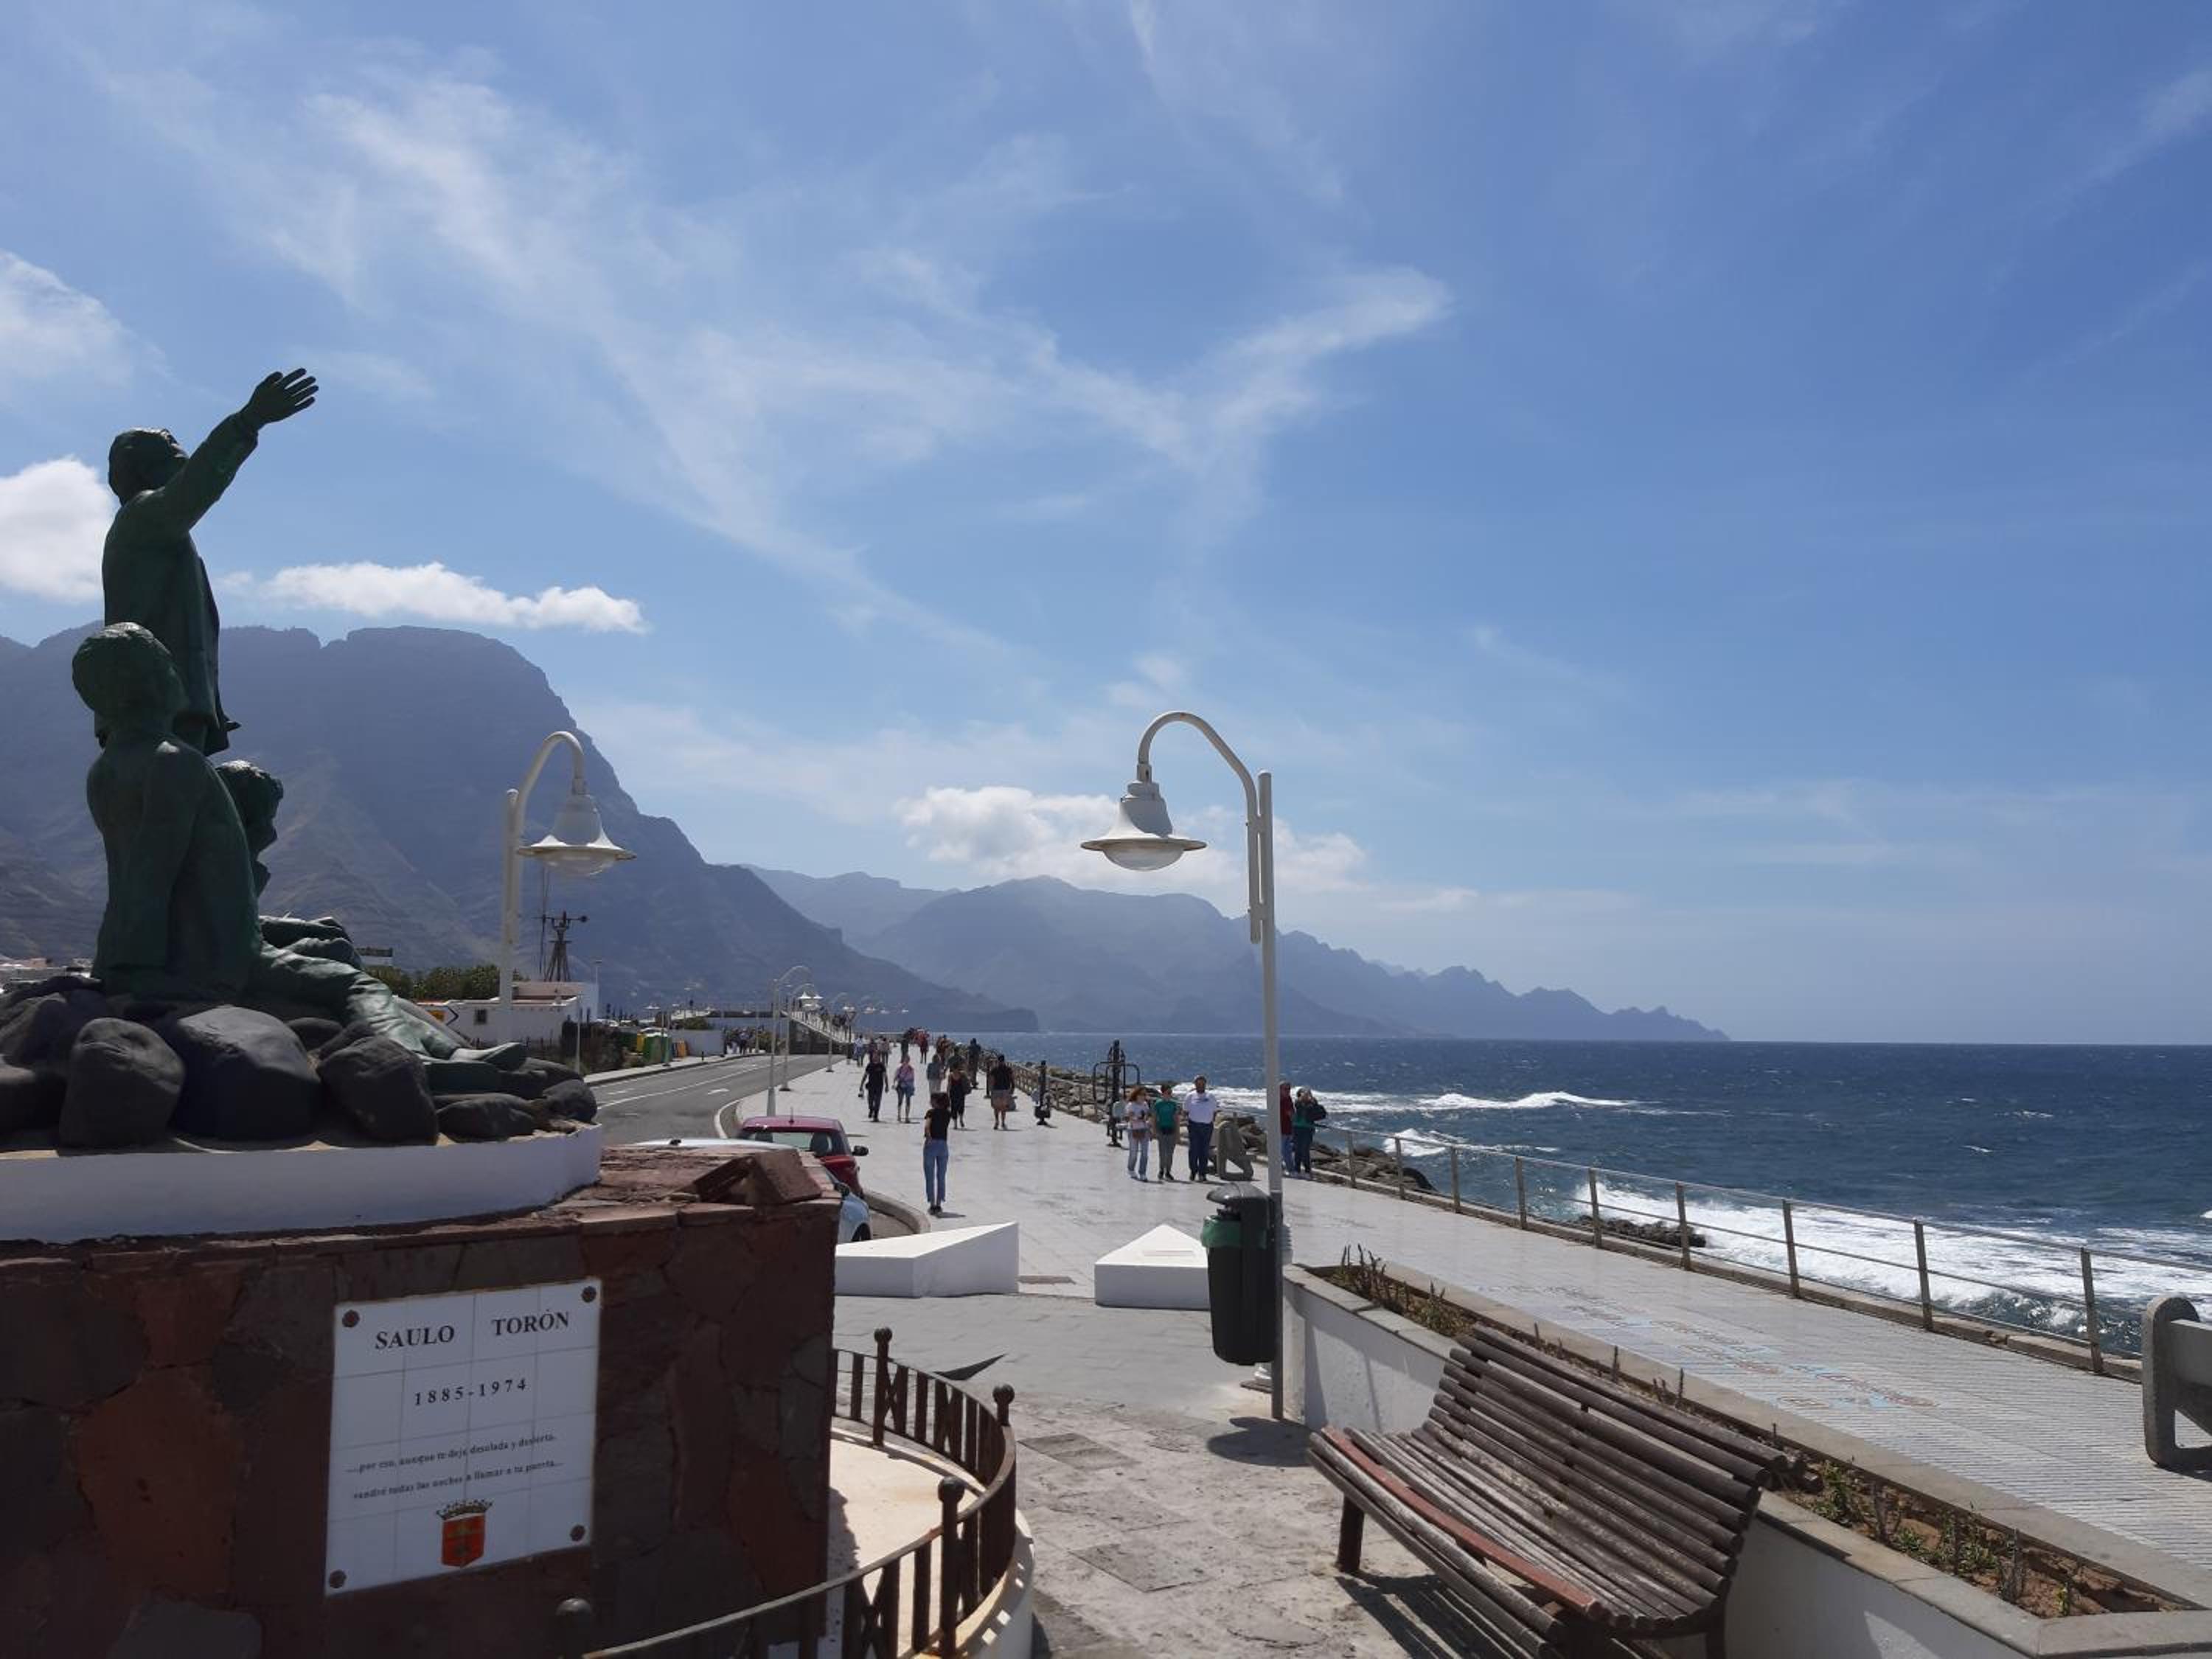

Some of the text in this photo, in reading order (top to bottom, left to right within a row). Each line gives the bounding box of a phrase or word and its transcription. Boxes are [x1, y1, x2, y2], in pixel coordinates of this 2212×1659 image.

[375, 1309, 570, 1350] SAULO TORÓN
[414, 1378, 529, 1406] 1885-1974
[470, 1440, 508, 1455] desolada
[510, 1441, 516, 1452] y
[389, 1484, 414, 1495] todas
[416, 1481, 431, 1491] las
[432, 1475, 463, 1488] noches
[473, 1468, 503, 1482] llamar
[514, 1464, 524, 1473] tu
